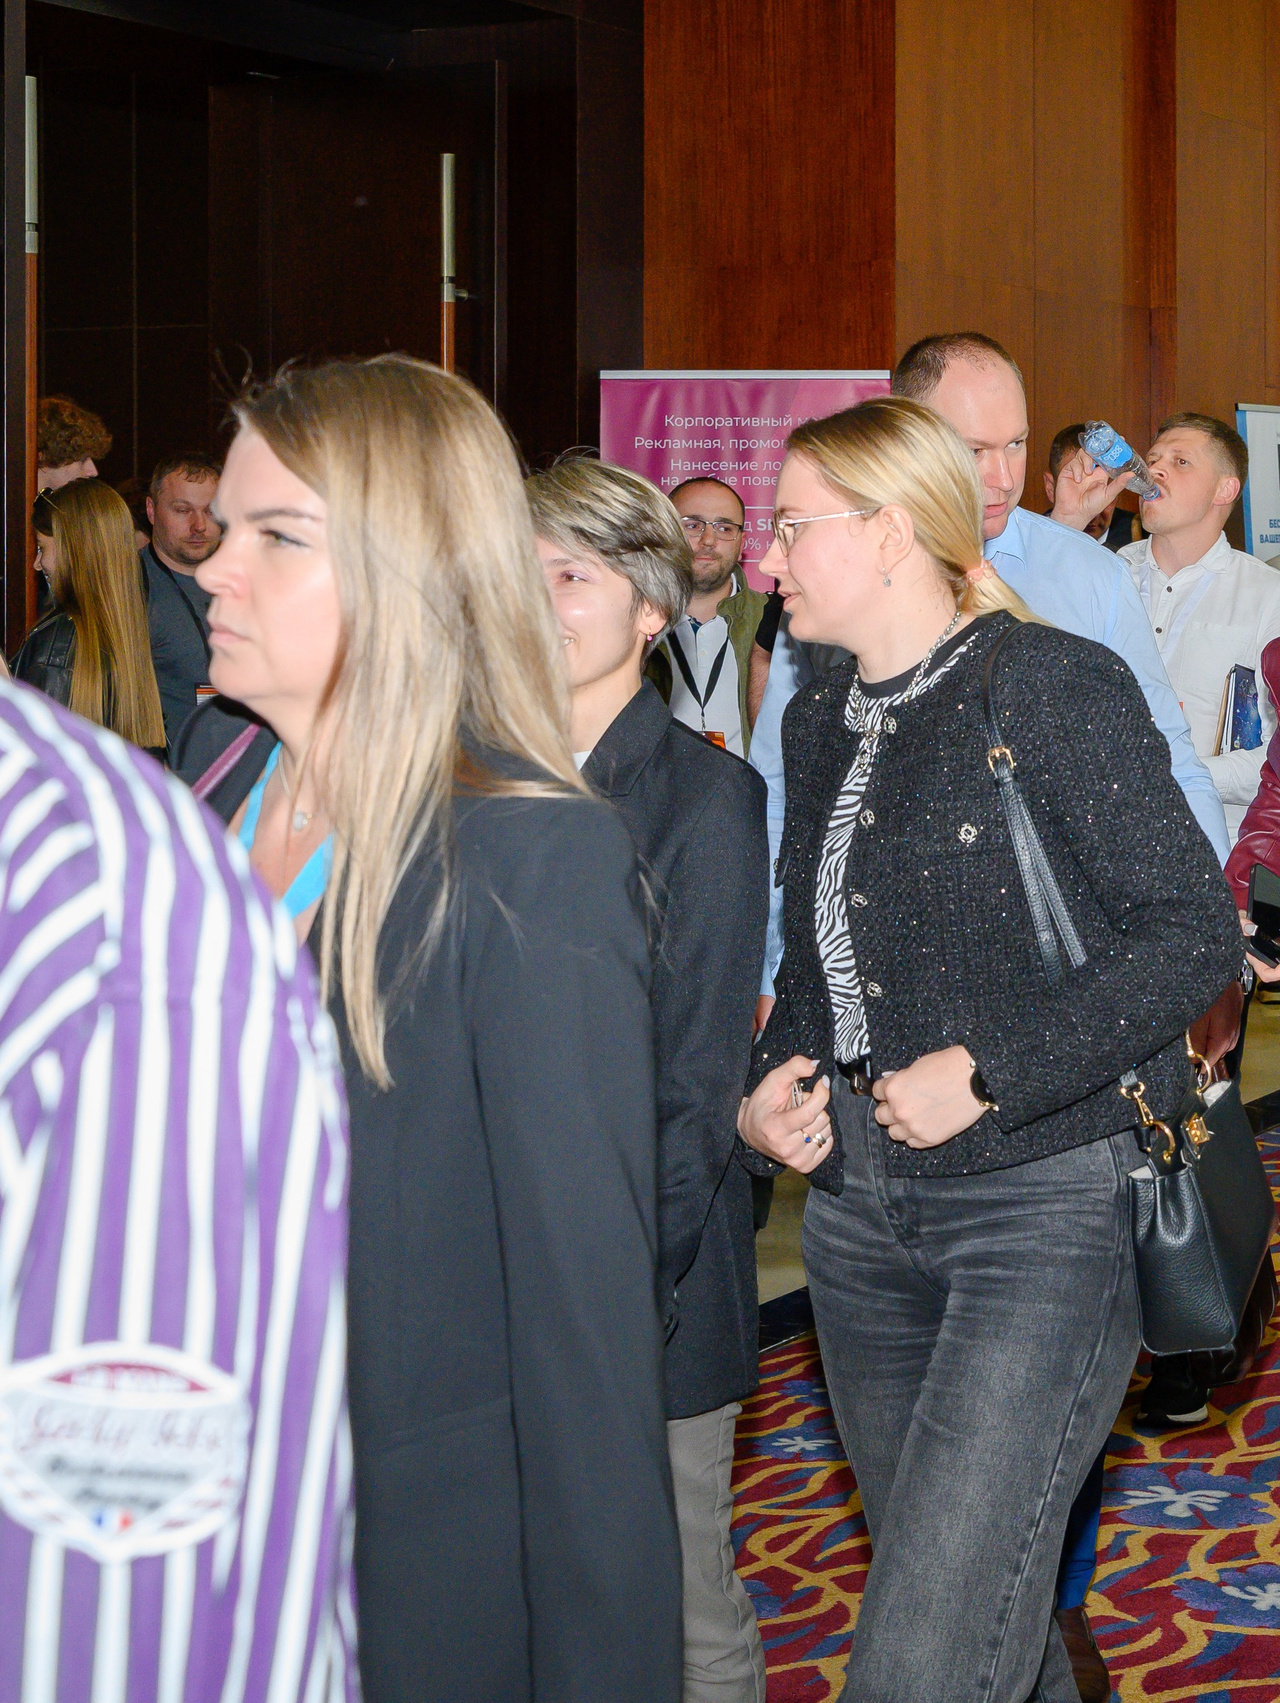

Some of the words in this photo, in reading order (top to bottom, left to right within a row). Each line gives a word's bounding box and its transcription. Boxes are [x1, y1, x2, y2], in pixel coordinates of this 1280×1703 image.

[664, 414, 792, 429] Корпоративный
[634, 436, 725, 451] Рекламная,
[670, 458, 758, 471] Нанесение
[661, 476, 680, 486] на
